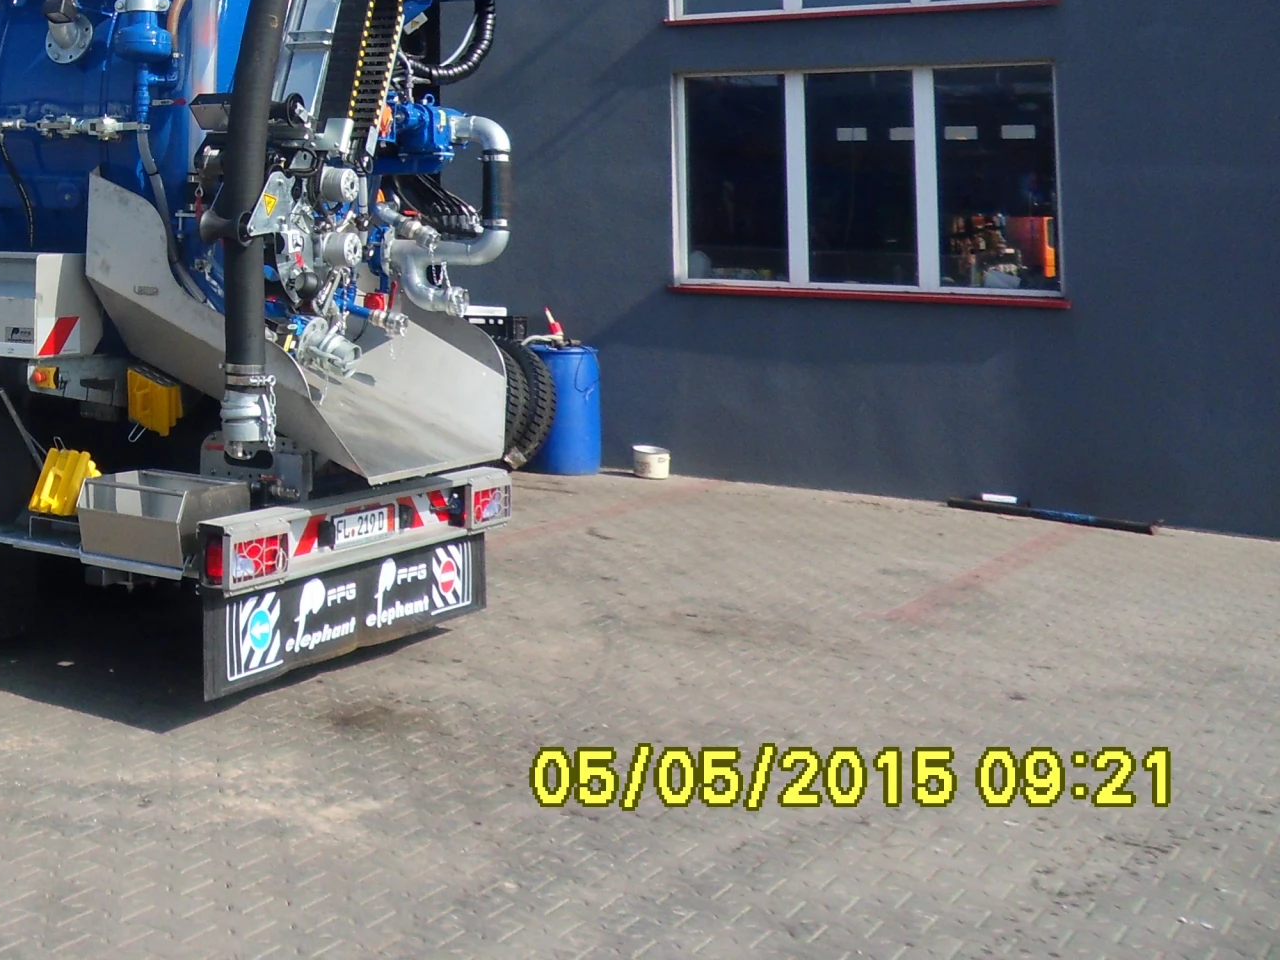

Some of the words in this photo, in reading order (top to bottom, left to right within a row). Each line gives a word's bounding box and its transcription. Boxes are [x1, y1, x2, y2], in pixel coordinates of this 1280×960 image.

[397, 563, 427, 585] FFG
[327, 582, 357, 607] FFG
[365, 594, 430, 628] elephant
[284, 616, 356, 653] elephant
